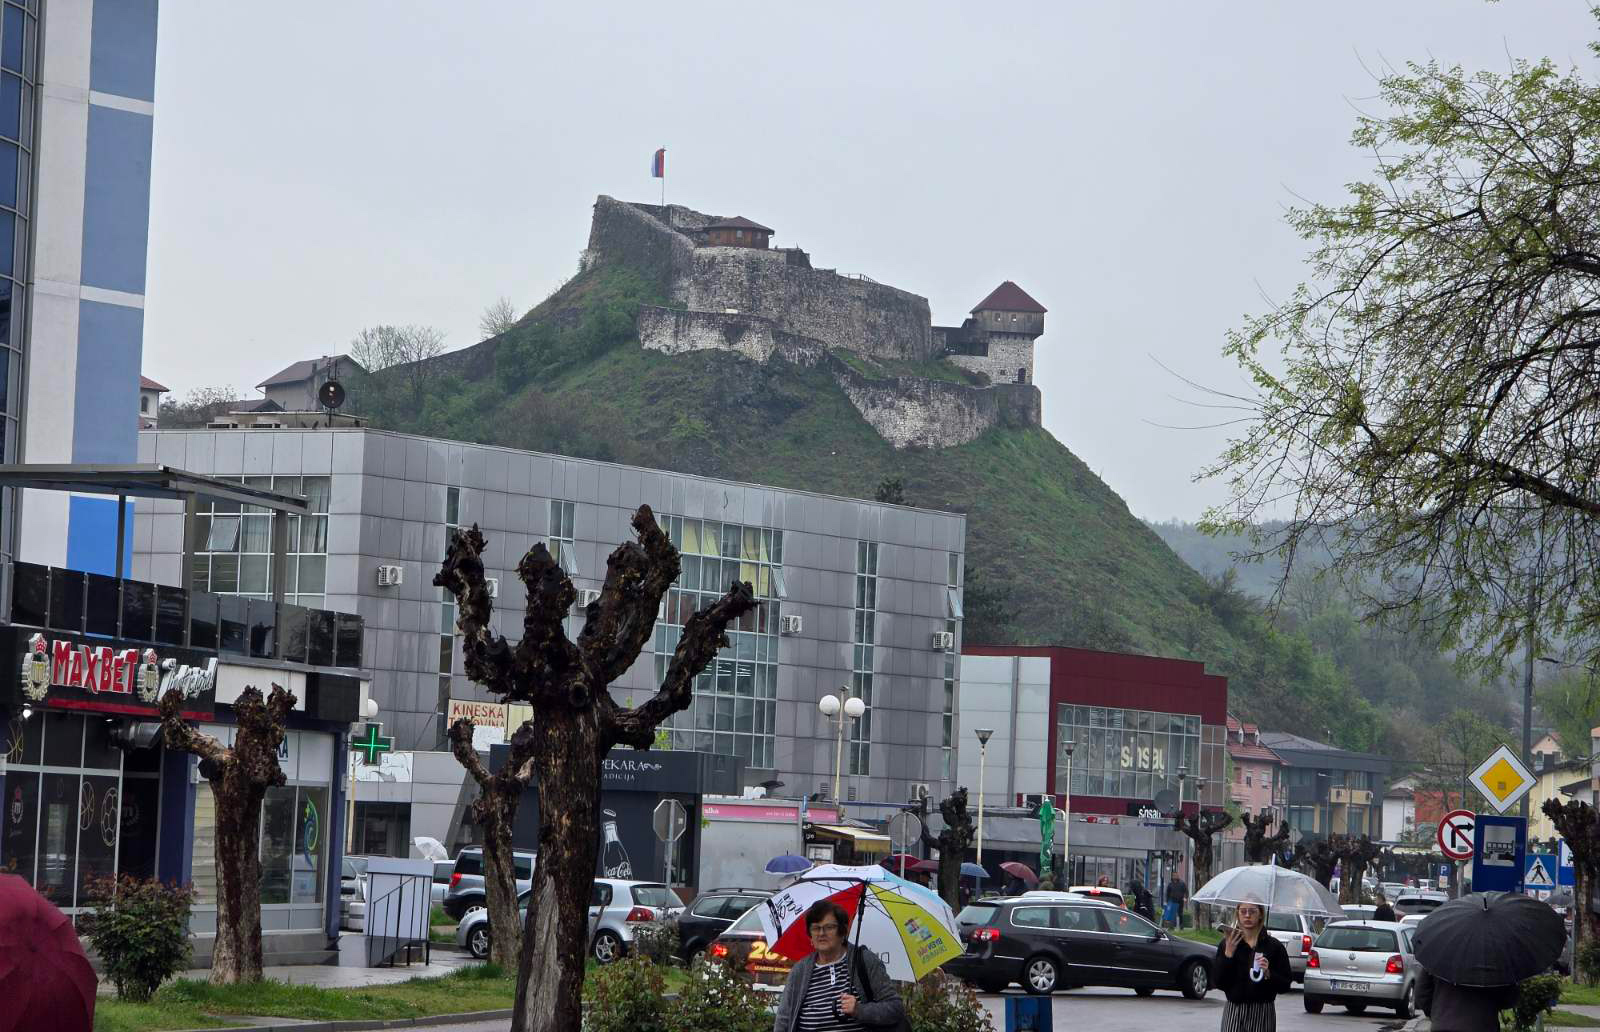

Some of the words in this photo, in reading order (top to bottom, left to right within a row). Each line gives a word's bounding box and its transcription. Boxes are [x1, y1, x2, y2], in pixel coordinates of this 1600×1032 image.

[52, 639, 139, 695] MAXBET
[453, 703, 504, 719] KINESKA
[1120, 736, 1165, 779] sinsay
